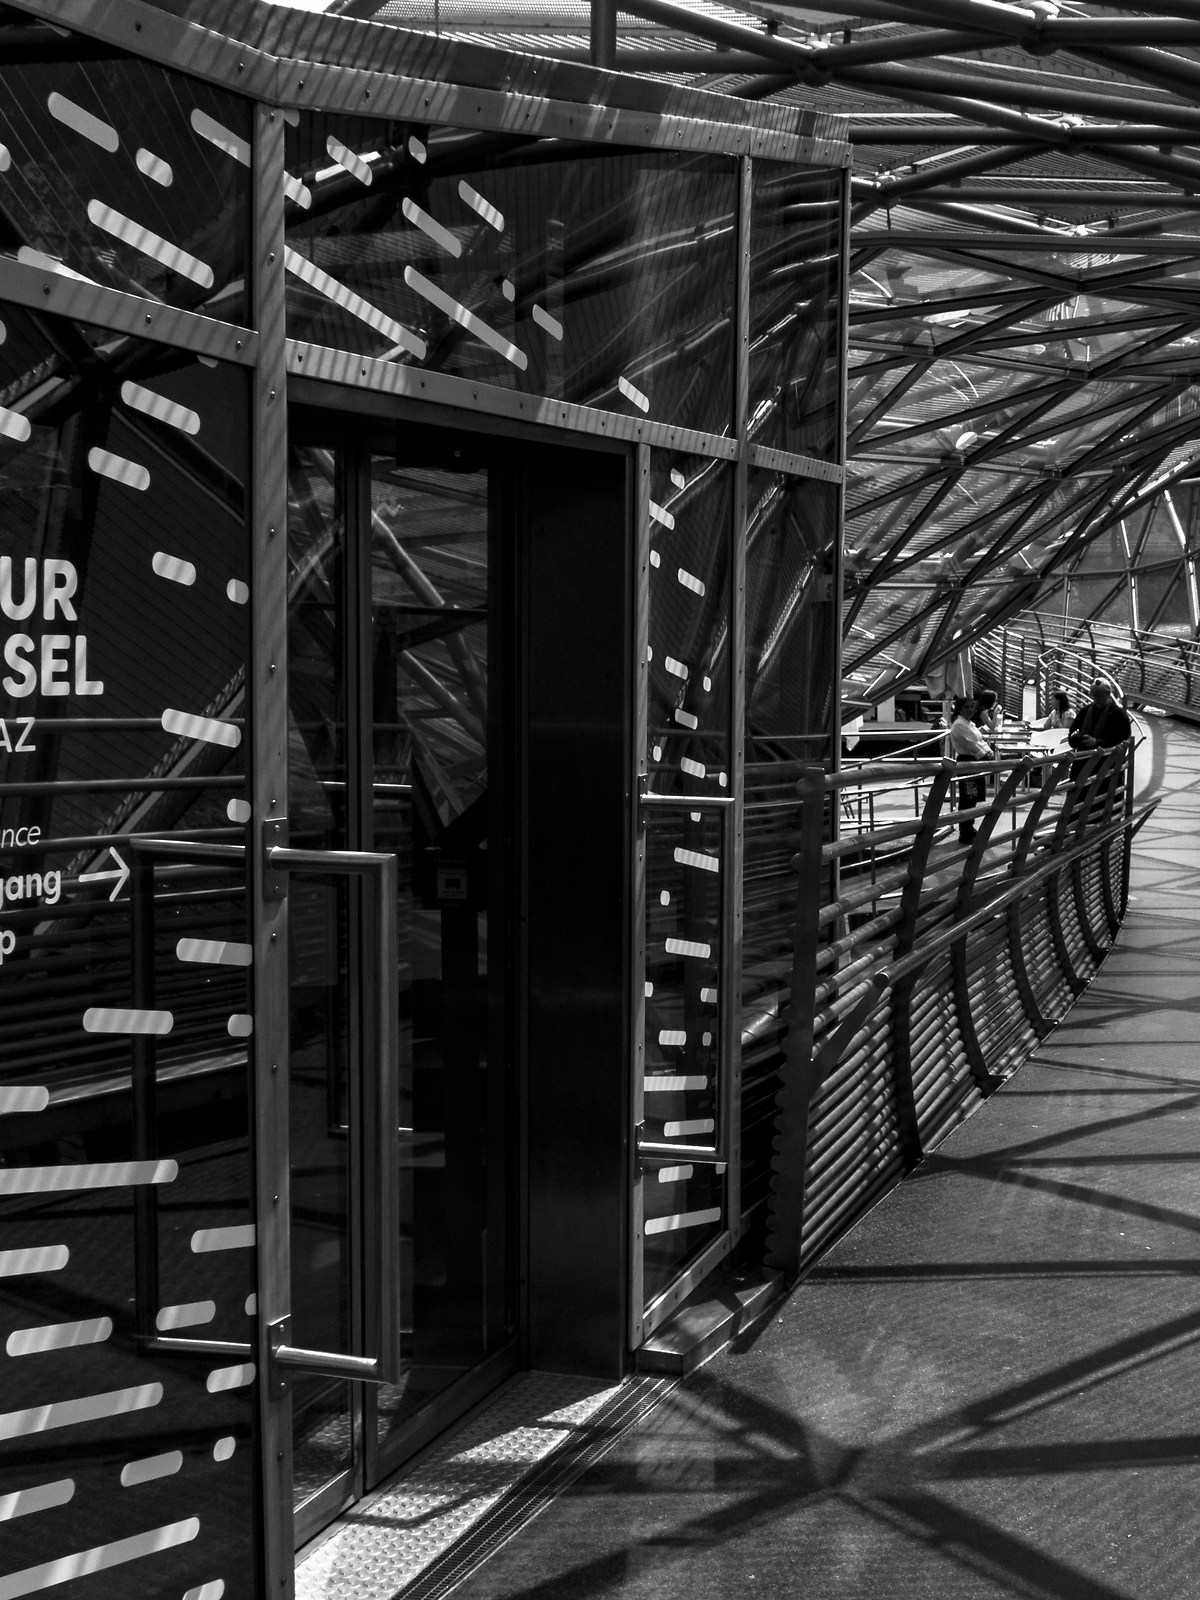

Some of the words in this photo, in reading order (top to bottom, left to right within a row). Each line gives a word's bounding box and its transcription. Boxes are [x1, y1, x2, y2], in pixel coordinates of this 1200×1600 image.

[0, 555, 78, 621] UR
[2, 633, 104, 698] SEL
[1, 825, 41, 848] nce
[0, 870, 62, 911] ang
